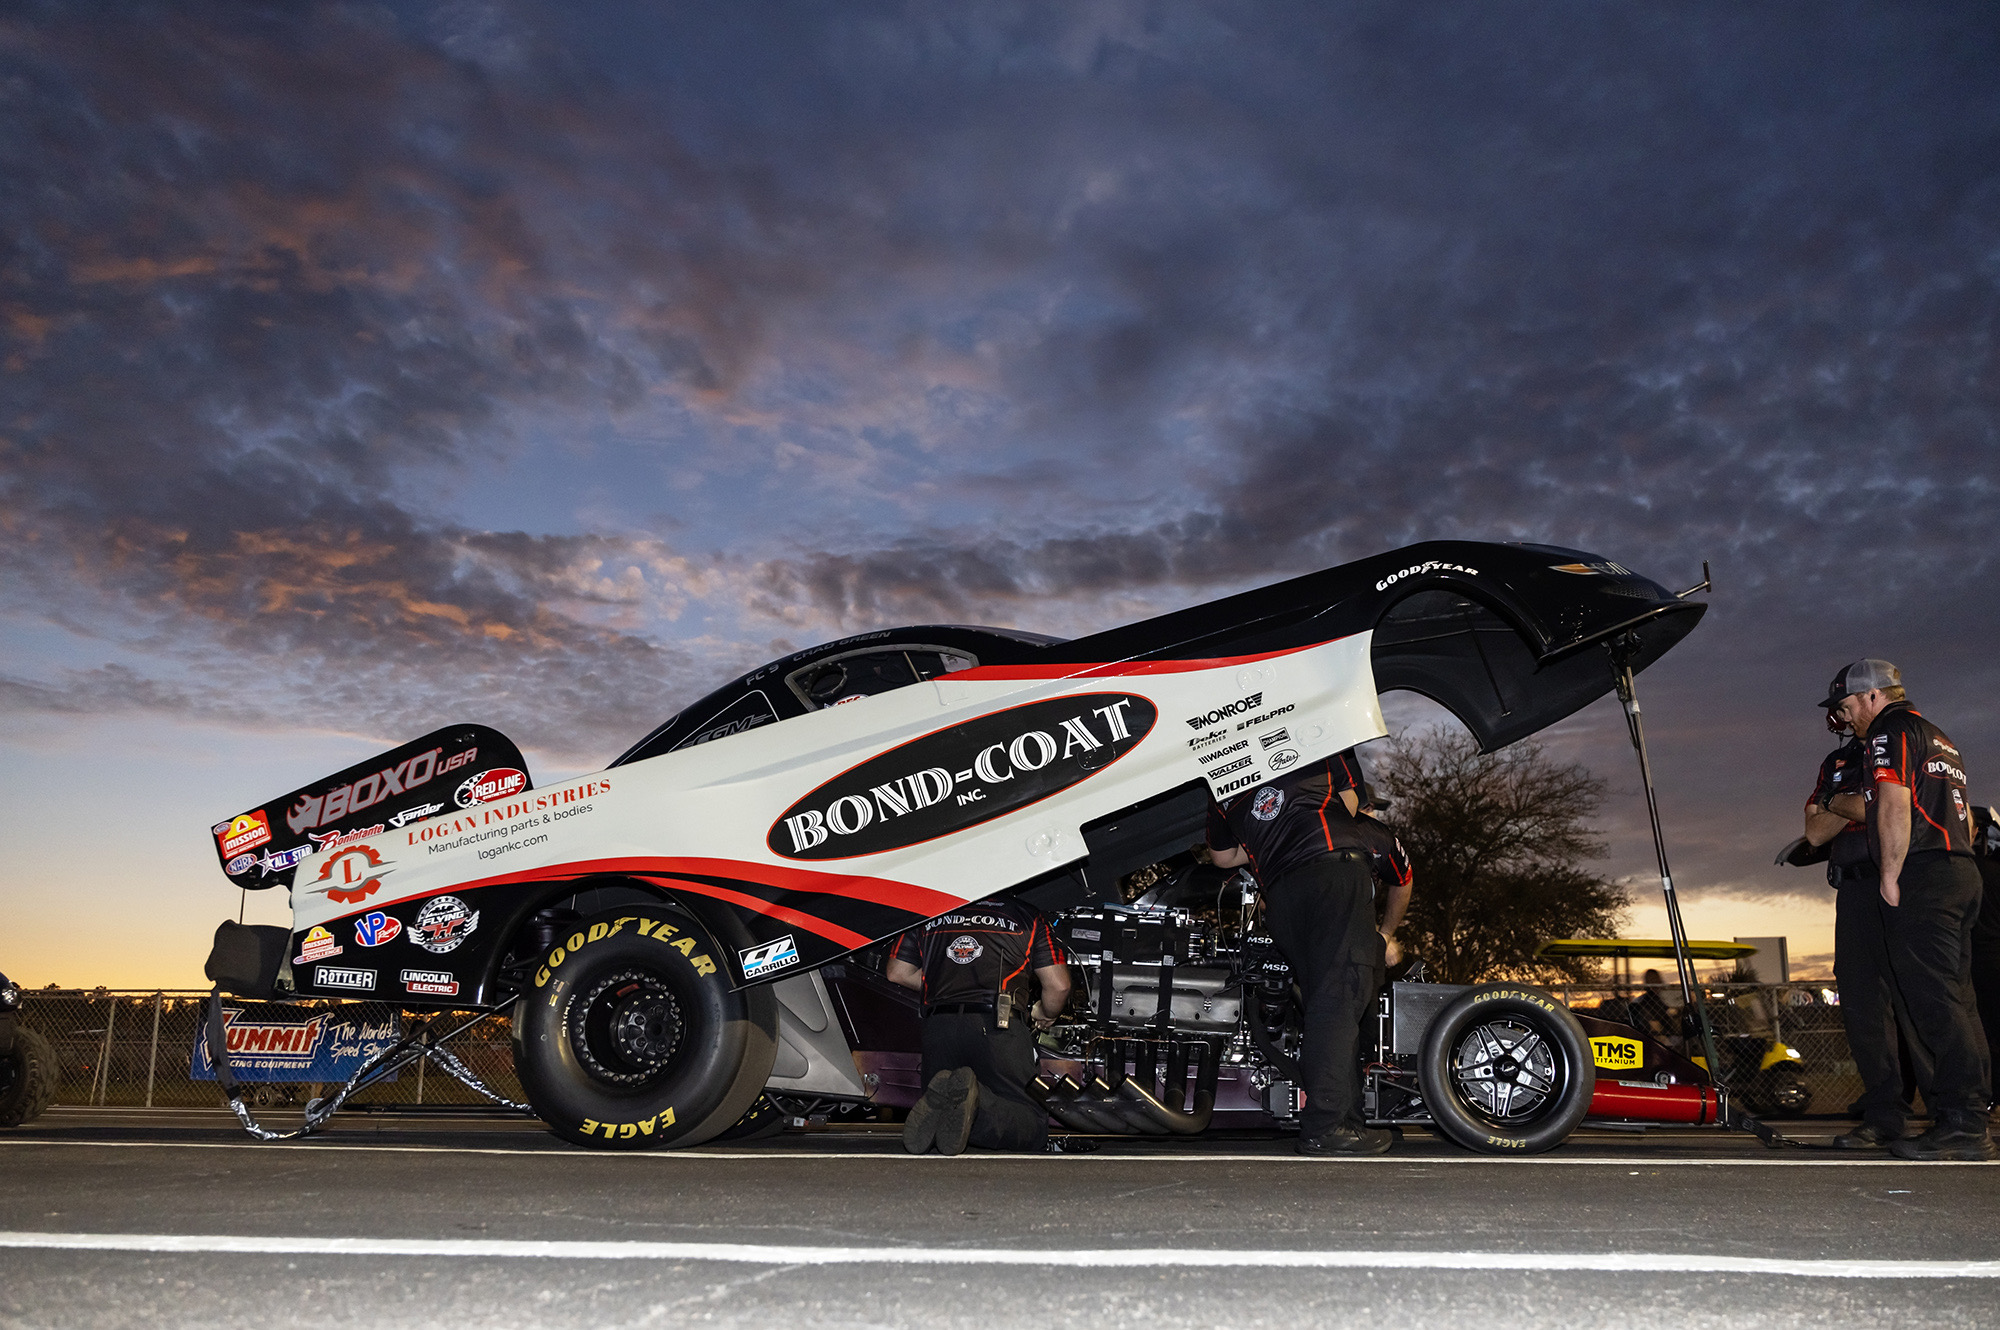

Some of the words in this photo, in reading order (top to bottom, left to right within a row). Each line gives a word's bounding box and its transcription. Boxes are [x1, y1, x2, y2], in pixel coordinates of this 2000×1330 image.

[1376, 560, 1479, 591] GOODYEAR
[745, 673, 764, 686] FC
[839, 631, 892, 645] GREEN
[1198, 697, 1257, 729] MONROE
[1192, 734, 1227, 751] BATTERIES
[1207, 740, 1249, 760] WAGNER
[1207, 757, 1253, 779] WALKER
[1270, 753, 1297, 770] Gates
[475, 781, 496, 798] RED
[498, 773, 522, 791] LINE
[784, 698, 1132, 853] BOND-COAT
[1216, 771, 1261, 796] MOOG
[318, 750, 438, 826] BOXO
[436, 748, 478, 775] USA
[957, 789, 986, 806] INC.
[388, 803, 444, 827] Sander
[408, 814, 477, 846] LOGAN
[484, 778, 611, 825] INDUSTRIES
[428, 825, 508, 855] Manufacturing
[511, 815, 540, 835] parts
[542, 814, 551, 824] &
[553, 803, 593, 821] bodies
[275, 855, 289, 867] ALL
[292, 847, 310, 862] STAR
[477, 833, 548, 860] logankc.com
[229, 857, 254, 872] NHRA
[342, 858, 363, 885] L
[355, 912, 386, 946] VP
[422, 911, 464, 926] FLYING
[1247, 936, 1273, 944] MSD
[534, 916, 718, 988] GOODYEAR
[744, 939, 791, 966] CP
[746, 955, 798, 977] CARRILLO
[1262, 963, 1289, 971] MSD
[403, 972, 450, 983] LINCOLN
[412, 983, 453, 993] ELECTRIC
[1474, 990, 1555, 1012] GOODYEAR
[329, 1021, 356, 1043] The
[330, 1042, 362, 1064] Speed
[1594, 1041, 1636, 1059] TMS
[1595, 1057, 1635, 1065] TITANIUM
[230, 1060, 252, 1068] CING
[255, 1060, 313, 1069] EQUIPMENT
[579, 1106, 677, 1139] EAGLE
[1487, 1135, 1526, 1148] EAGLE
